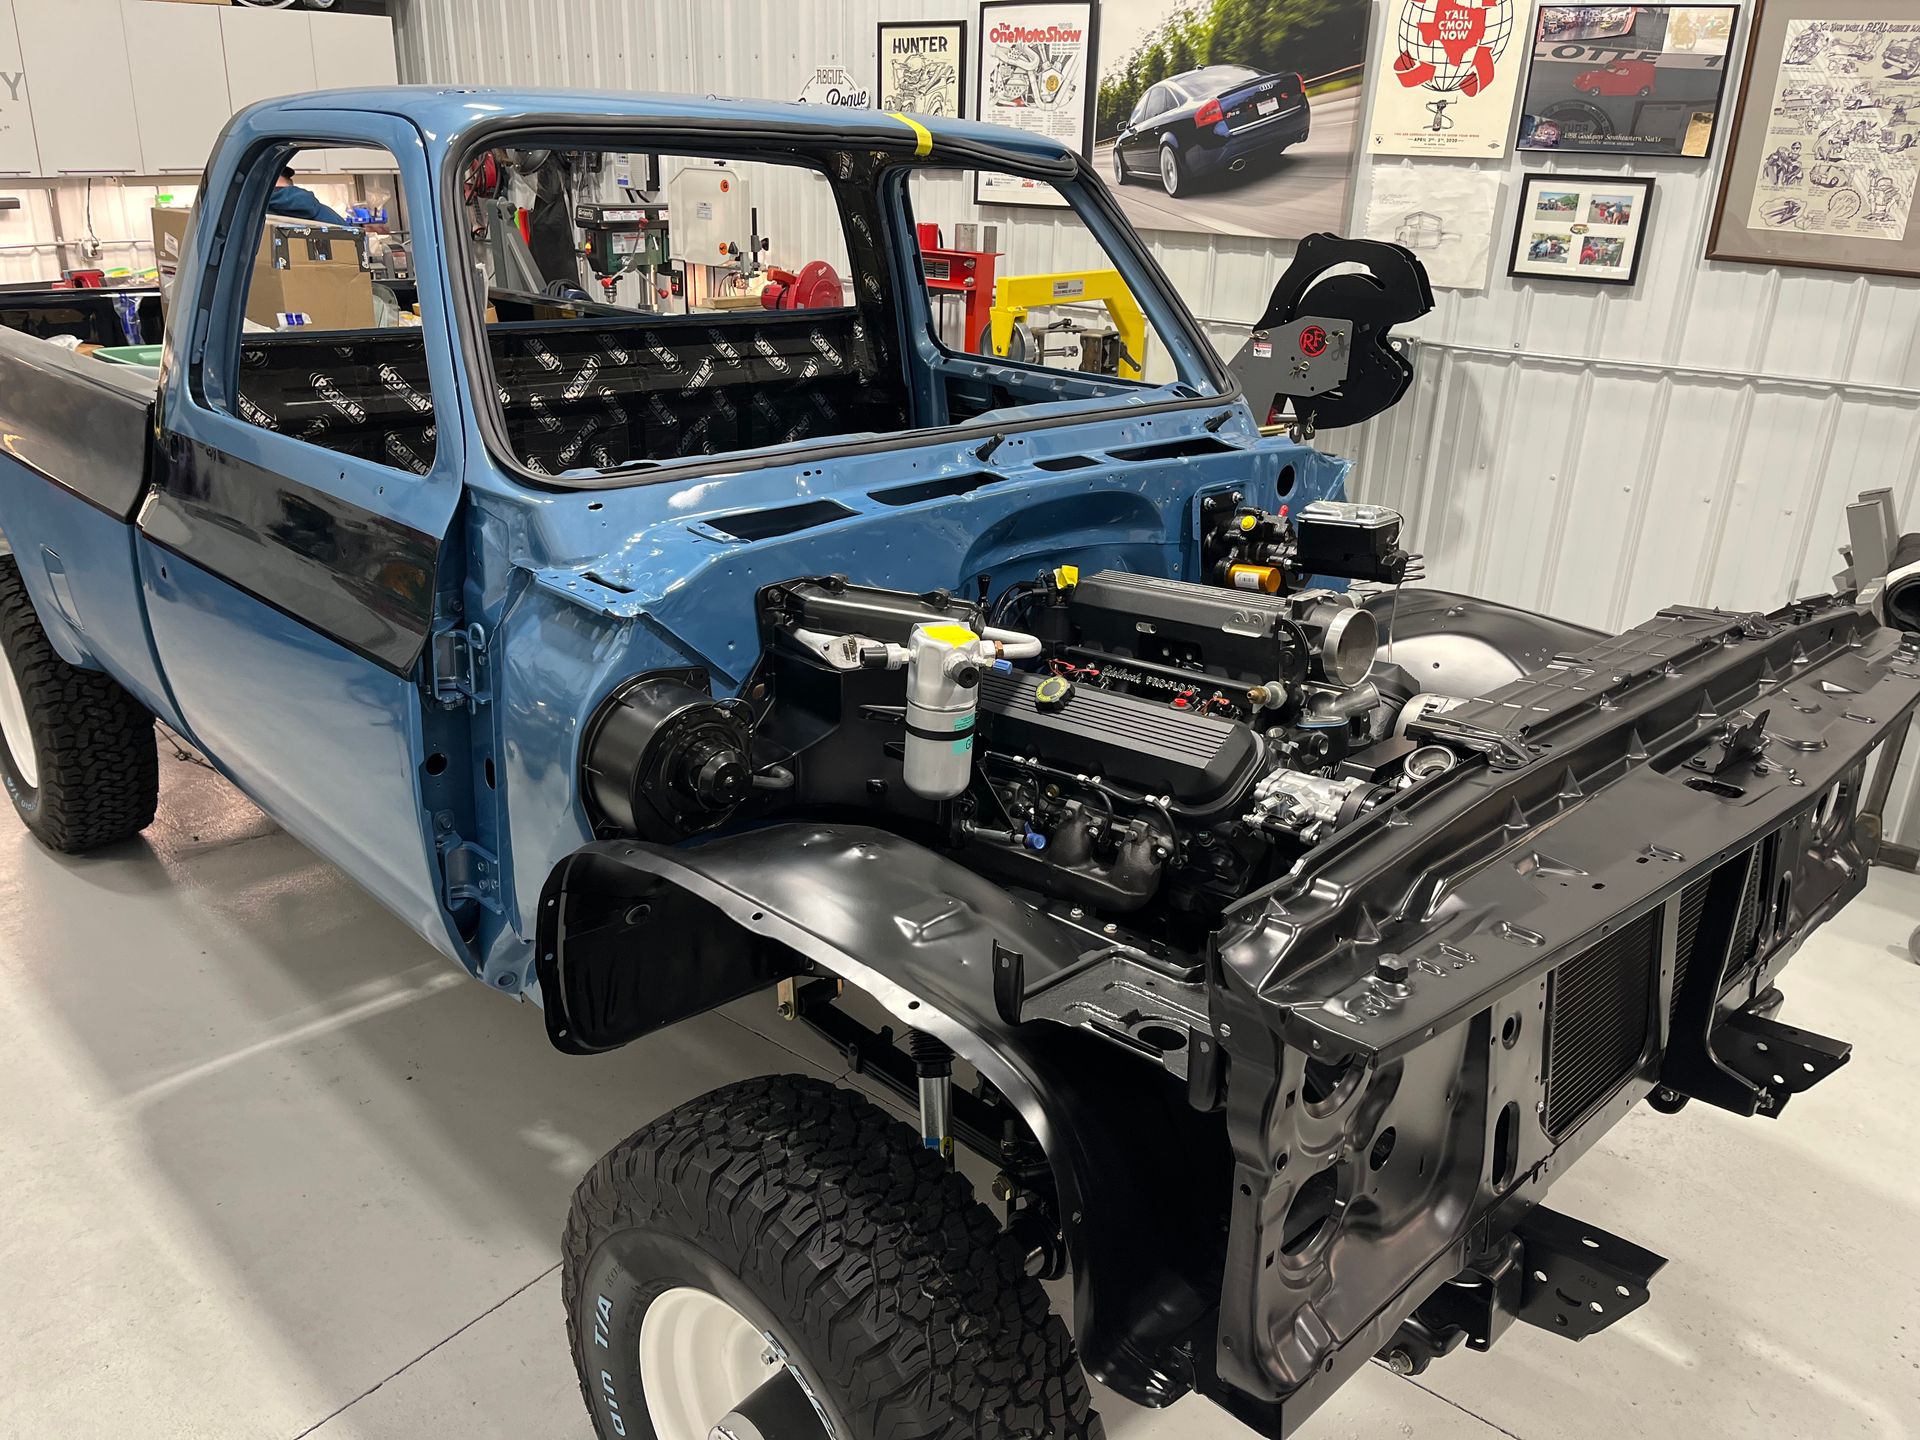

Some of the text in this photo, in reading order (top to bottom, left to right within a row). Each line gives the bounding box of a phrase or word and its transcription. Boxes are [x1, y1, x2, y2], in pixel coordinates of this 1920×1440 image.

[1445, 10, 1469, 20] Y'ALL
[999, 22, 1011, 31] The
[1438, 20, 1472, 30] C'MON
[1440, 30, 1469, 40] NOW
[893, 36, 948, 54] HUNTER
[816, 69, 844, 85] ROGUE
[1101, 664, 1142, 685] Edelbrock
[1145, 675, 1186, 693] PRO-FLO
[594, 1293, 614, 1350] T/A
